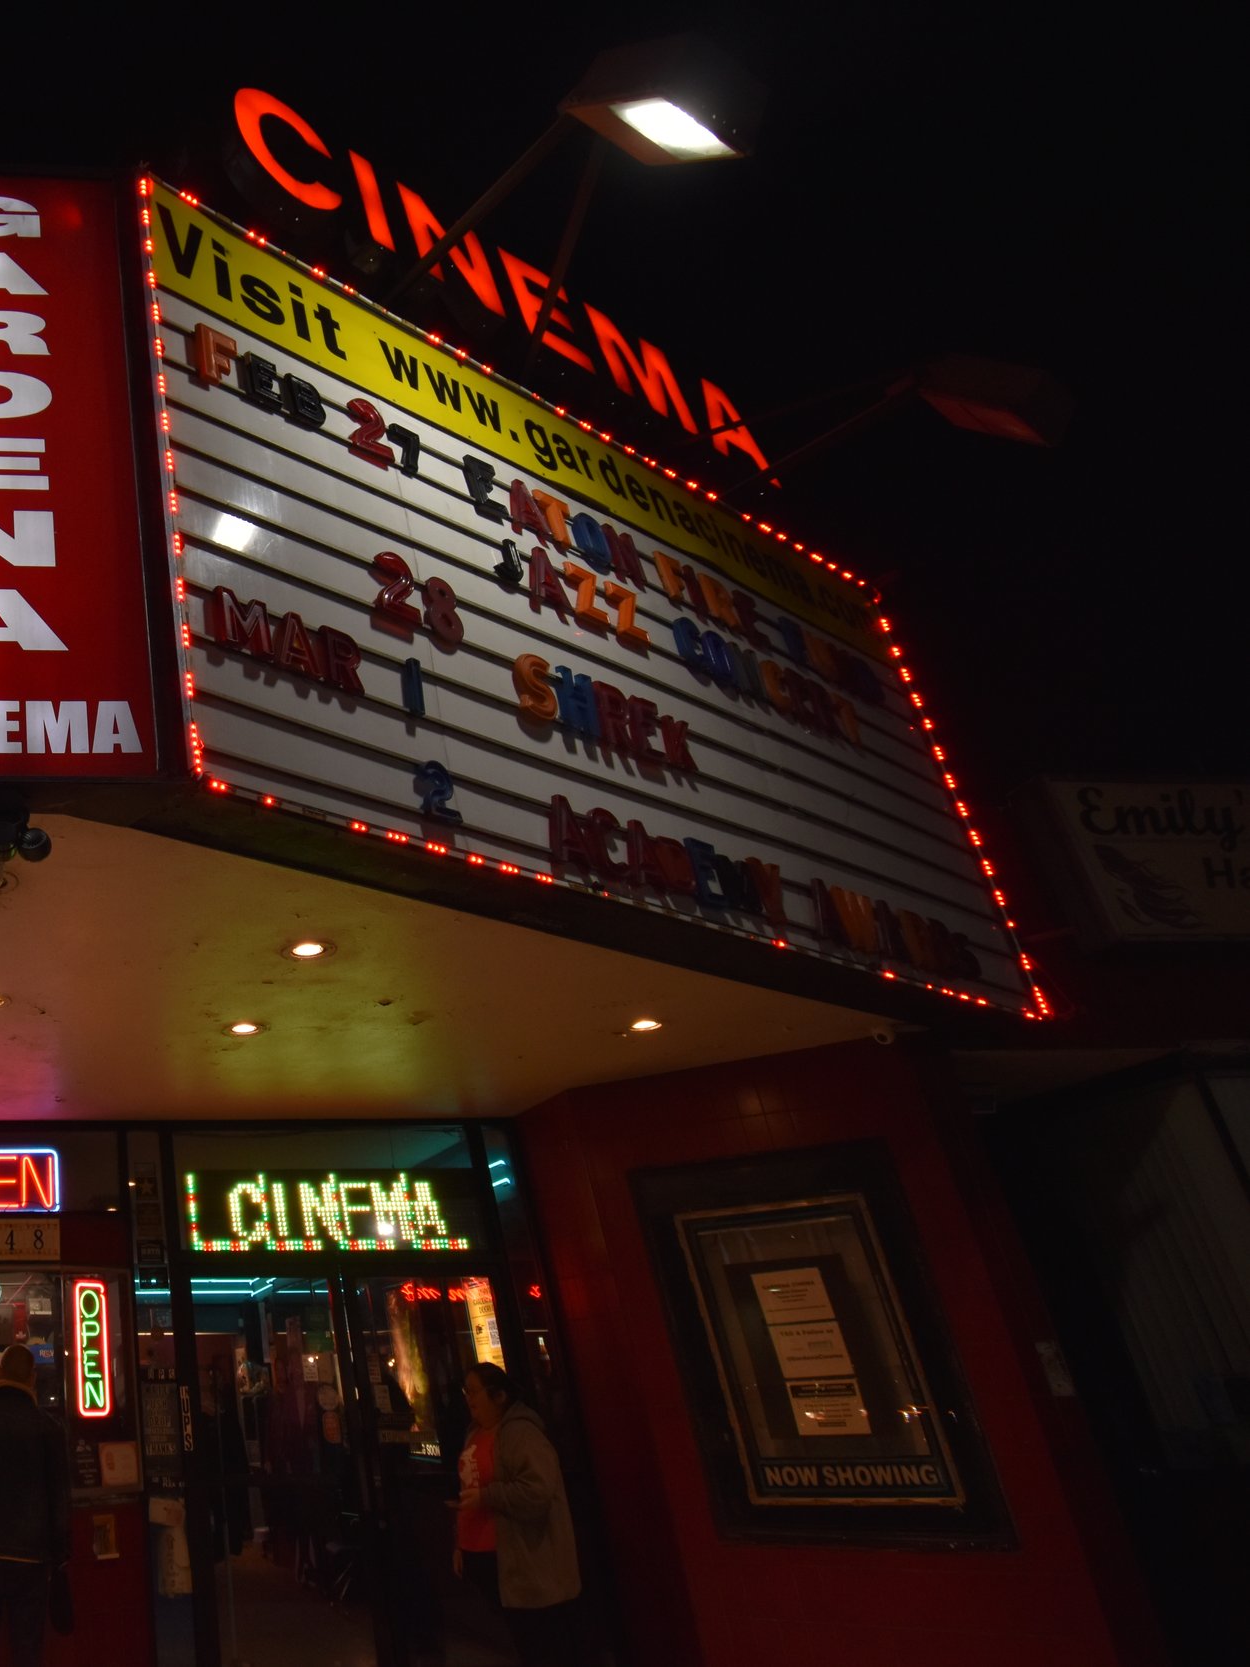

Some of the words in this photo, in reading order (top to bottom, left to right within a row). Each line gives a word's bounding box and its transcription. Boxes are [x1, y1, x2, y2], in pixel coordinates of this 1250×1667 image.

[234, 87, 781, 488] CINEMA
[156, 201, 347, 361] Visit
[379, 338, 873, 630] www.gardenacinema.com
[195, 323, 327, 428] FEB
[347, 398, 421, 477] 27
[462, 454, 647, 592] EATON
[212, 585, 365, 695] MAR
[513, 654, 697, 771] SHREK
[374, 551, 464, 653] 28
[493, 538, 650, 648] JAZZ
[414, 760, 463, 825] 2
[549, 794, 788, 927] ACADEMY
[79, 1289, 106, 1410] OPEN
[764, 1465, 821, 1488] NOW
[822, 1464, 940, 1487] SHOWING
